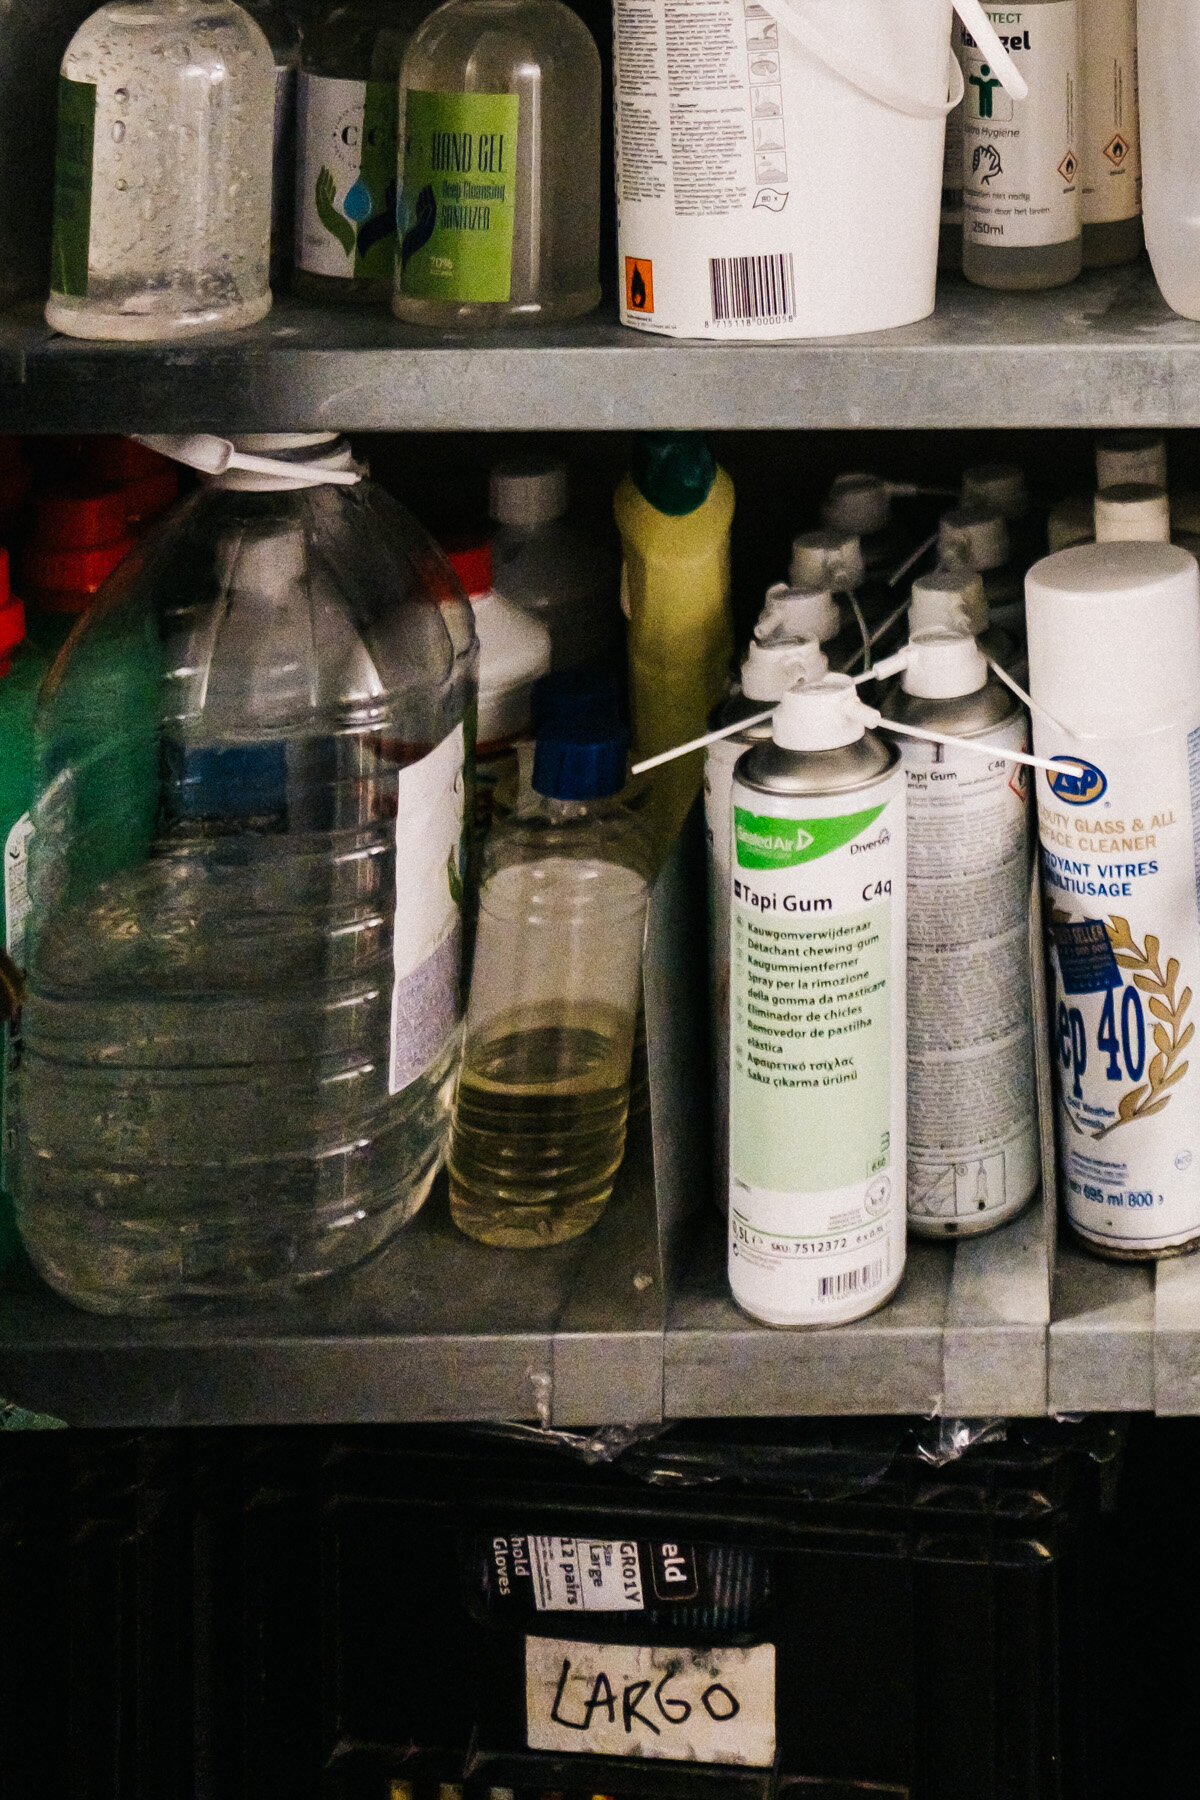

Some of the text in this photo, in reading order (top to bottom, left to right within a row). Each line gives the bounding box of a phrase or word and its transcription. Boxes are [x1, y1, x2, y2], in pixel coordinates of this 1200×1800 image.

[431, 132, 508, 173] HAND GEL
[440, 206, 491, 230] SANITIZER
[972, 221, 1004, 236] 250ml
[930, 771, 957, 782] Gum
[1074, 818, 1126, 835] GLASS
[1131, 818, 1144, 833] &
[1151, 810, 1177, 829] ALL
[1078, 833, 1157, 854] CLEANER
[1098, 860, 1159, 879] VITRES
[1044, 869, 1133, 898] ULTIUSAGE
[742, 885, 777, 913] Tapi
[783, 895, 833, 912] Gum
[747, 921, 872, 942] Kauwgomverwijderaar
[747, 938, 800, 957] Détachant
[747, 955, 859, 974] Kaugummientferner
[747, 971, 870, 991] Spray per la rimozione
[747, 979, 887, 1006] della gomma da masticare
[747, 1003, 863, 1022] Eliminador de chicles
[747, 1018, 873, 1039] Removedor de pastilha
[1058, 983, 1147, 1100] ep 40
[1107, 1192, 1124, 1206] ml
[1128, 1192, 1154, 1208] 800
[794, 1238, 847, 1254] 7512372
[492, 1537, 511, 1596] Gloves
[510, 1537, 530, 1577] hold
[588, 1543, 603, 1588] Large
[660, 1542, 688, 1583] eld
[559, 1563, 577, 1606] pairs
[550, 1658, 741, 1736] LARGO
